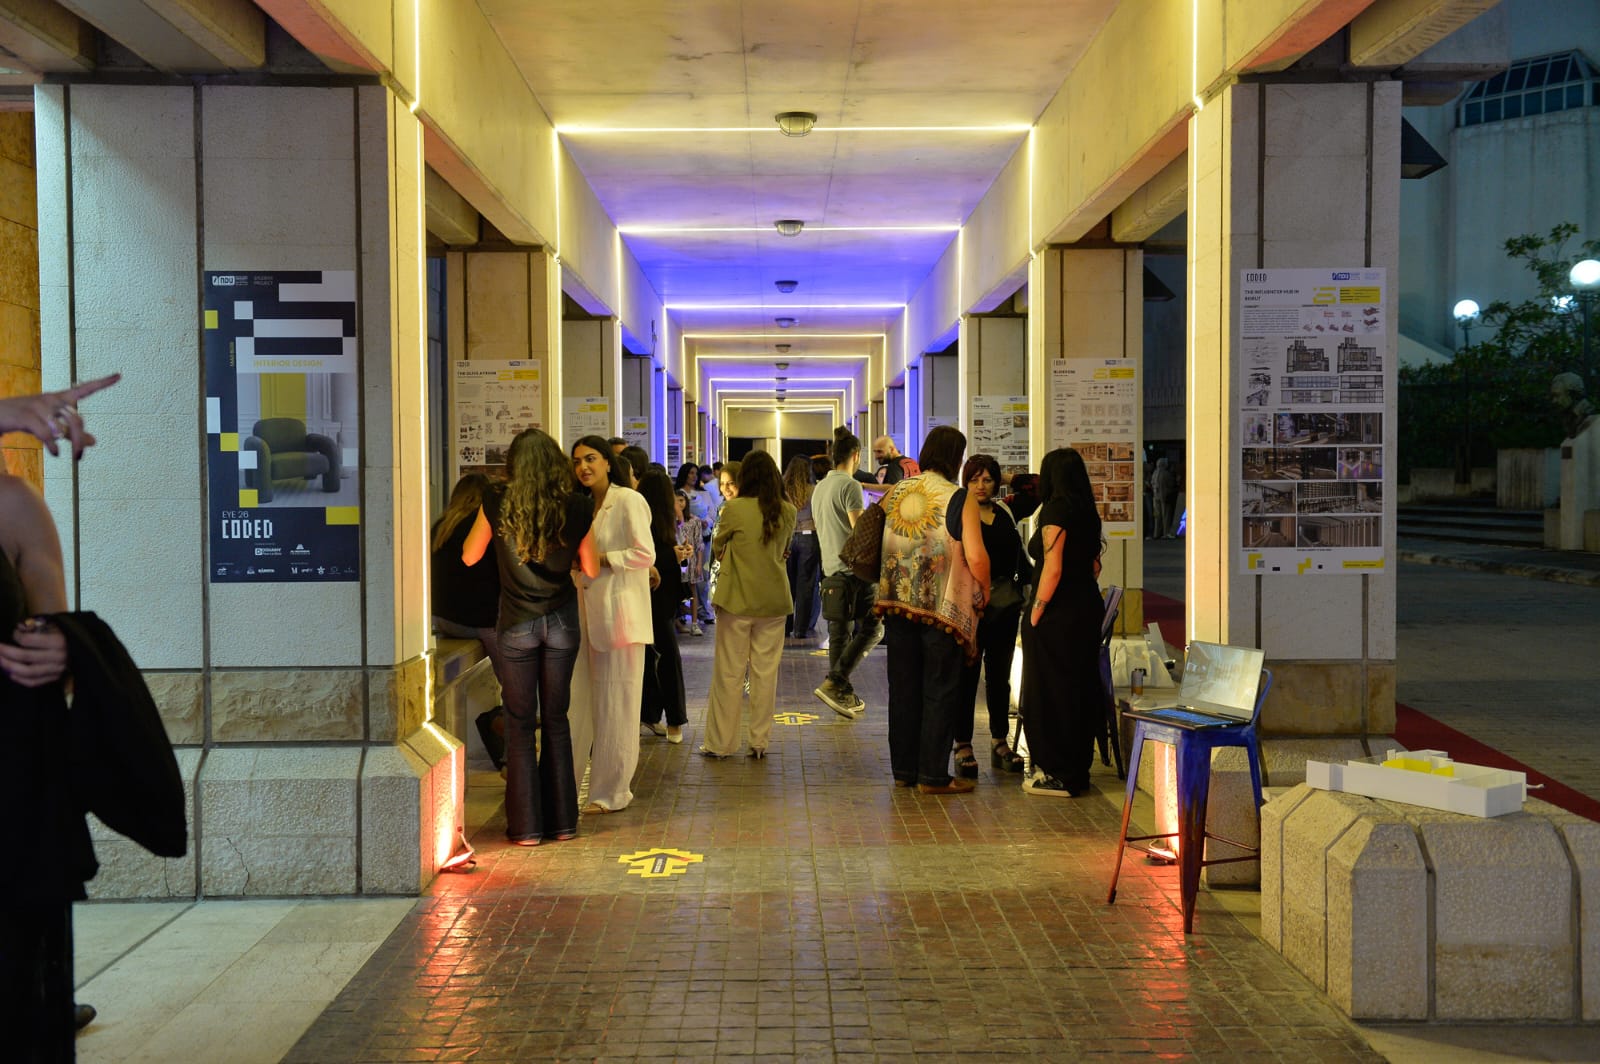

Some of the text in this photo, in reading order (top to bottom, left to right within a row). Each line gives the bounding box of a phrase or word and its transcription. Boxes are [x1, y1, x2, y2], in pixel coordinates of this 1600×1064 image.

[253, 359, 323, 367] INTERIOR DESIGN
[222, 510, 236, 518] EYE
[222, 519, 272, 538] CODED
